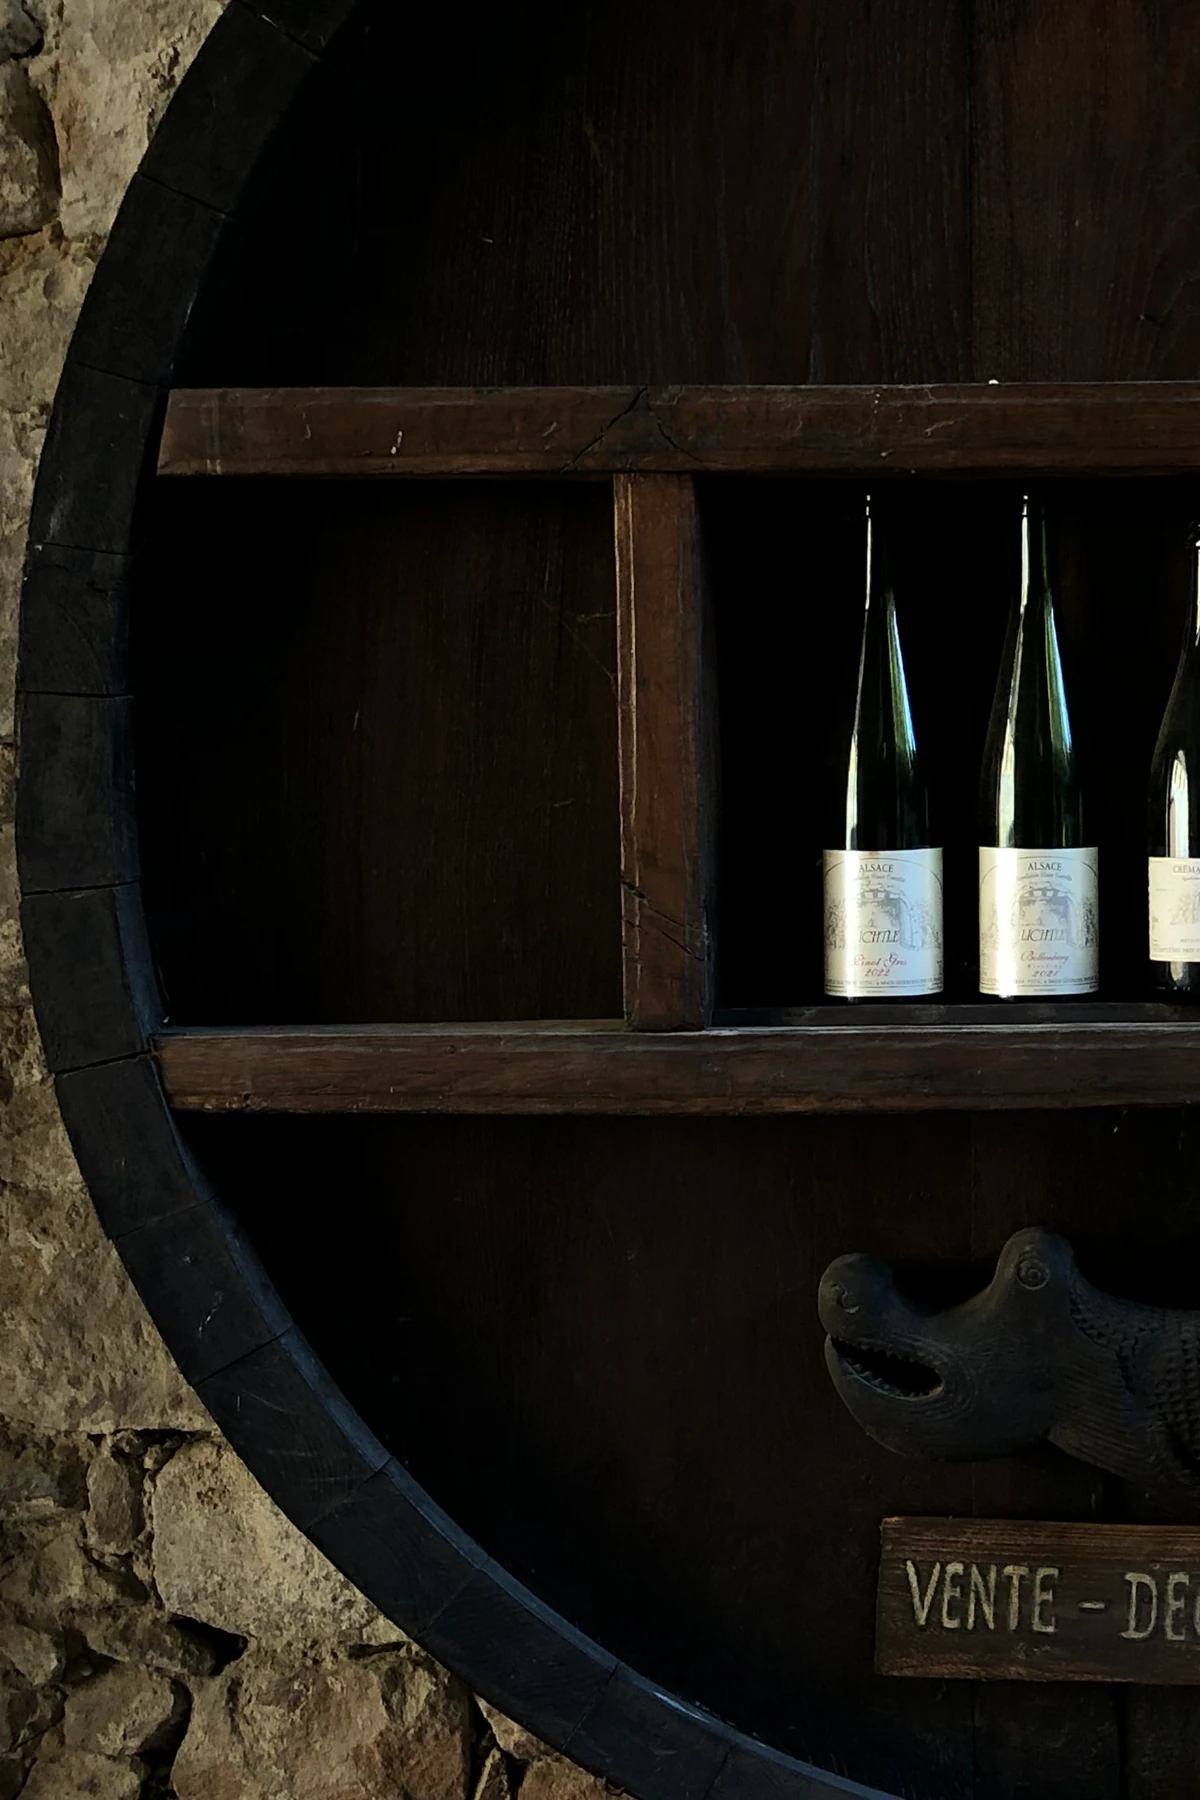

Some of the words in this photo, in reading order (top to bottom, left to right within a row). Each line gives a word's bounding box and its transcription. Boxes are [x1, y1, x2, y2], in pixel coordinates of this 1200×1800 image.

[859, 863, 894, 873] ALSACE
[1027, 861, 1063, 871] ALSACE
[906, 1559, 1059, 1634] VENTE
